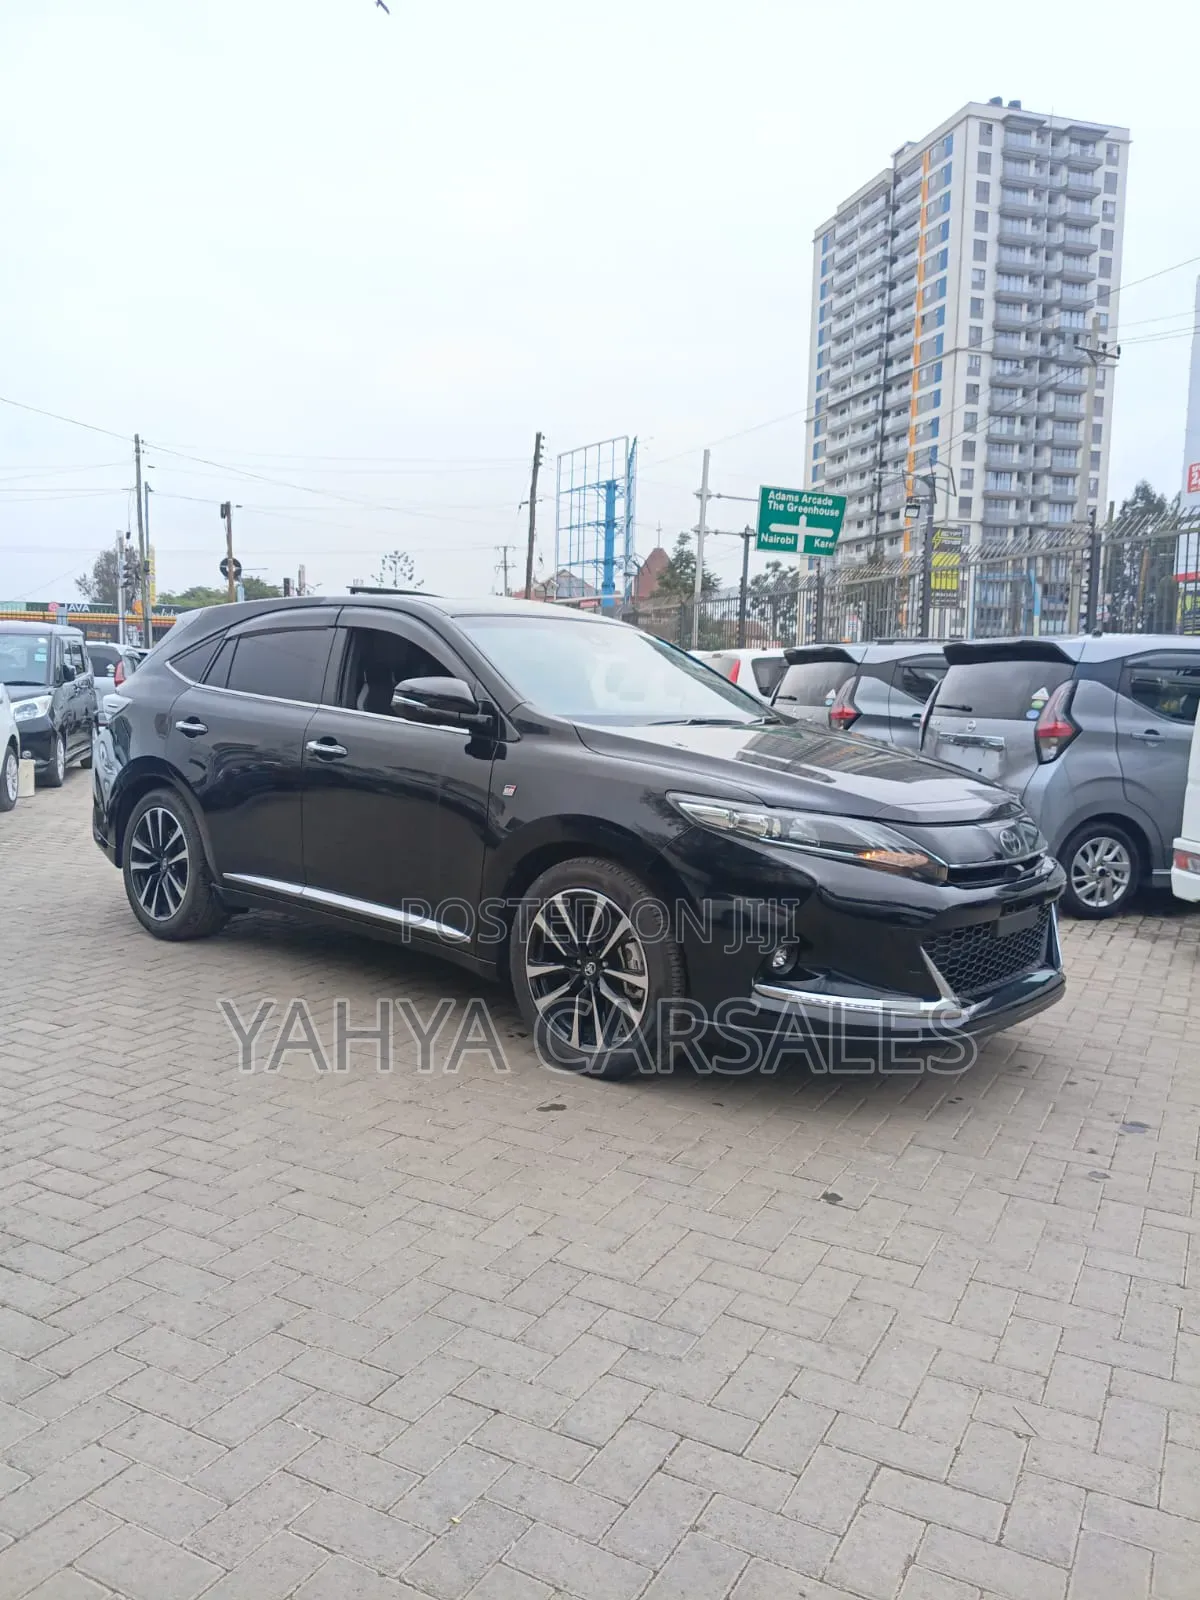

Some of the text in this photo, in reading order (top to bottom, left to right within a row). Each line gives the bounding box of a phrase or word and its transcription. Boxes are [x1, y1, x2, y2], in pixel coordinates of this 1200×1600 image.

[768, 490, 833, 506] Adams Arcade
[767, 500, 840, 517] The Greenhouse
[760, 532, 795, 545] Nairobi
